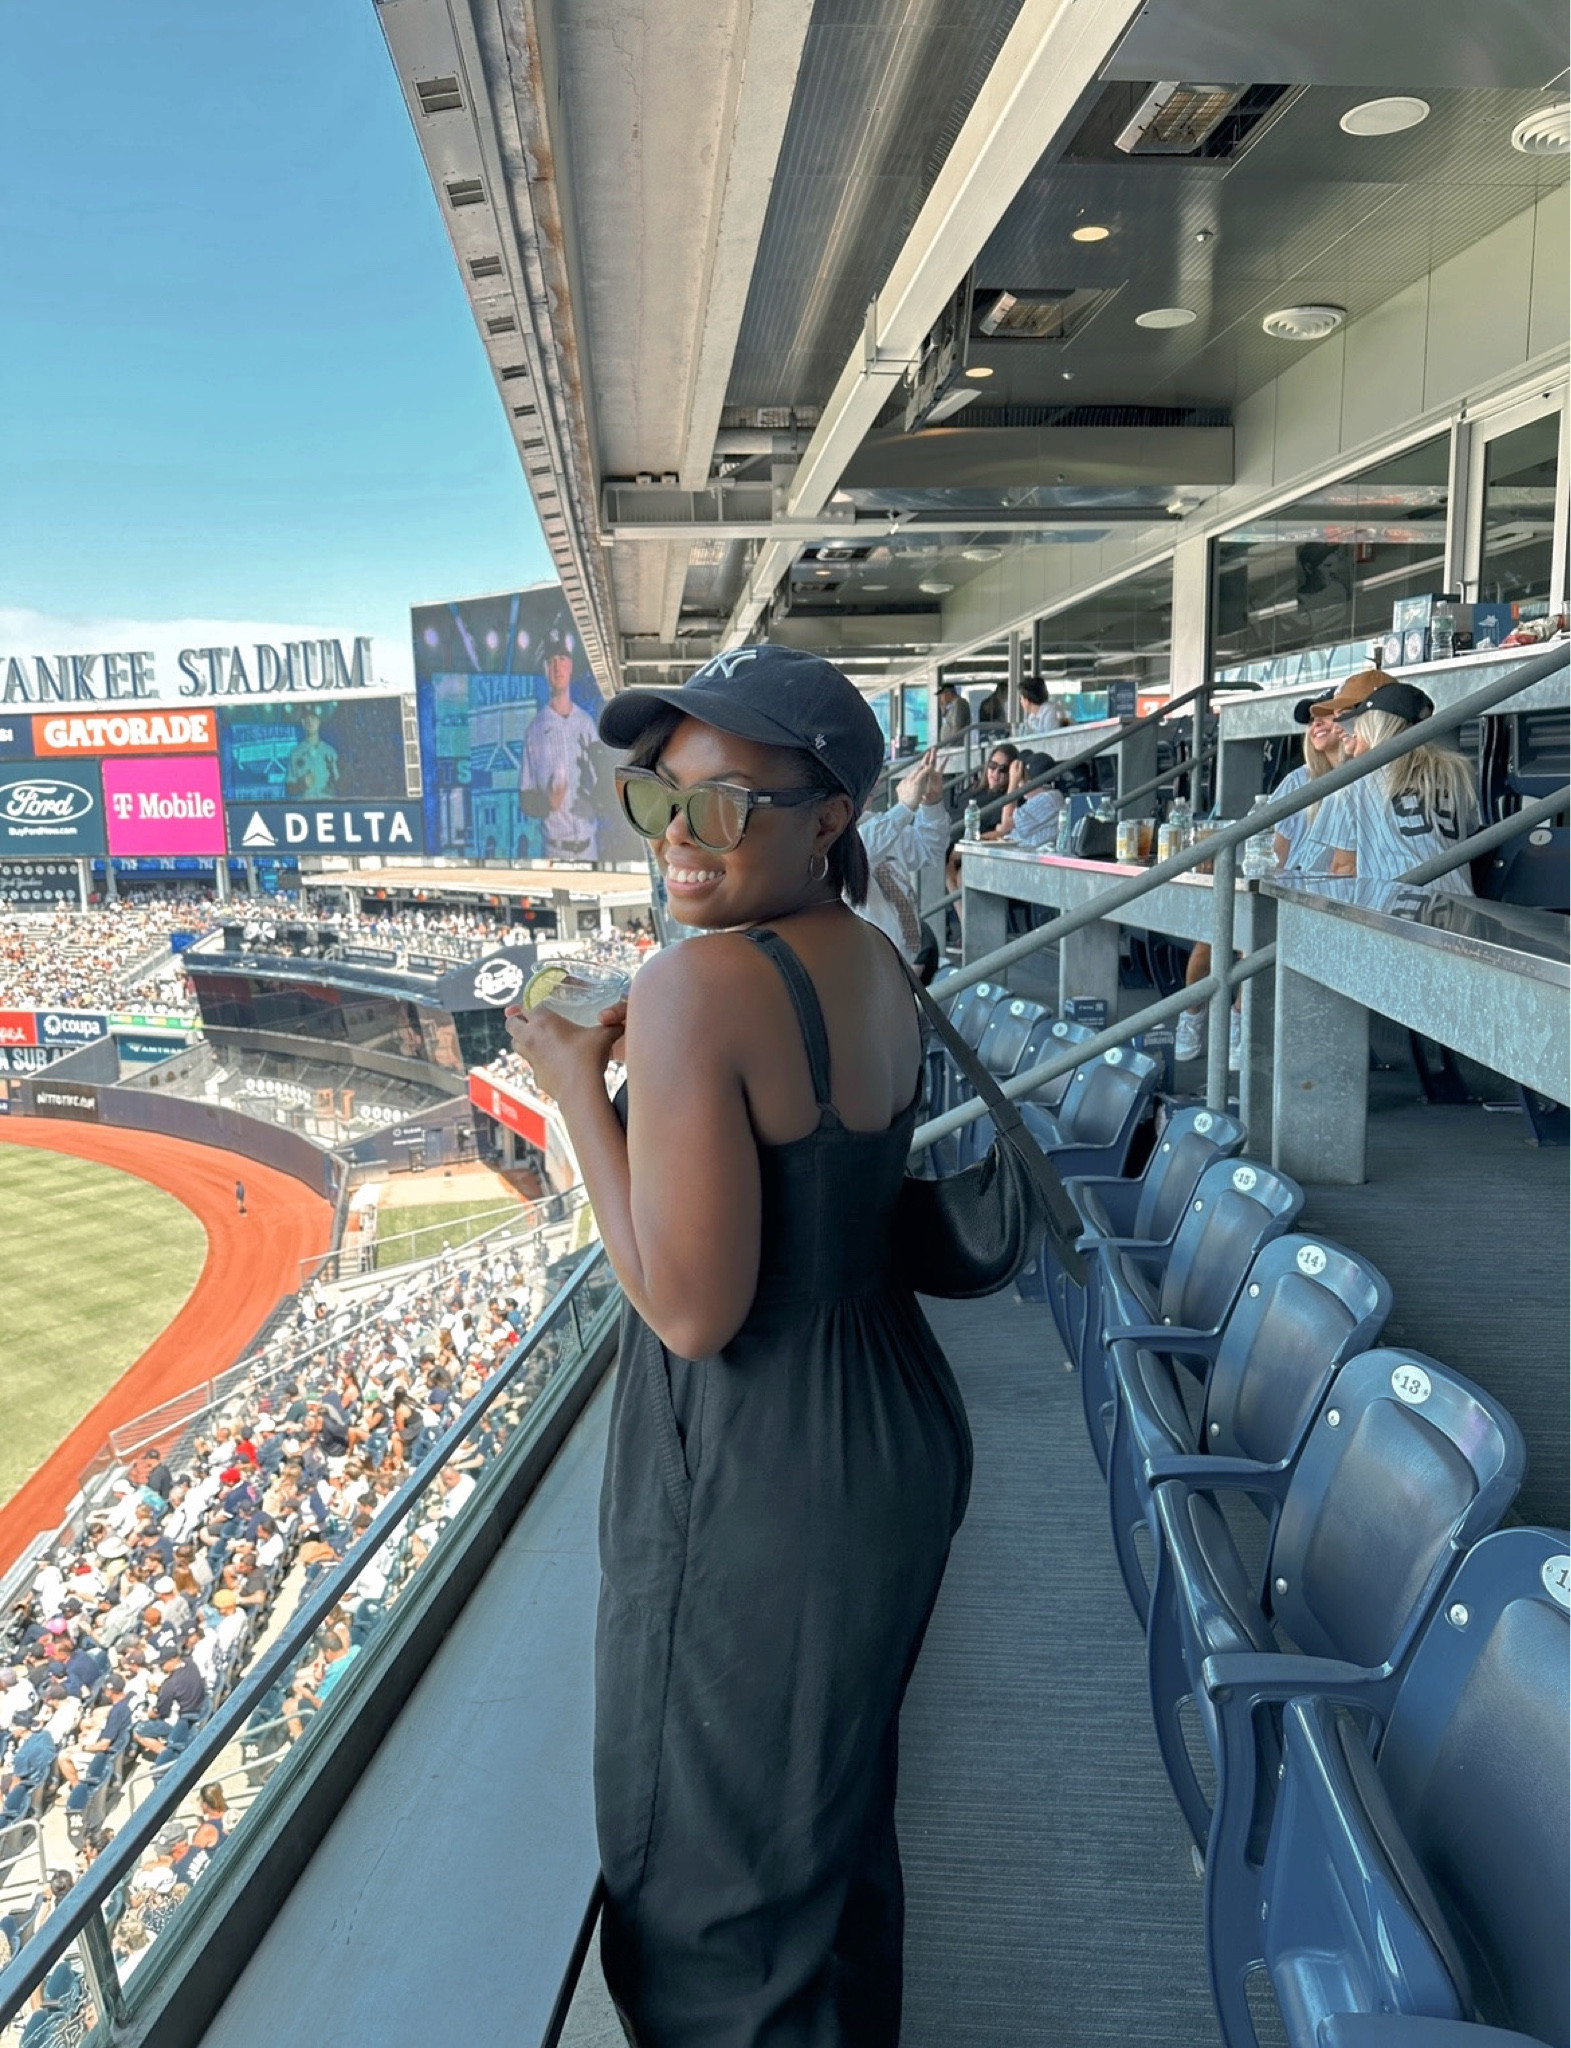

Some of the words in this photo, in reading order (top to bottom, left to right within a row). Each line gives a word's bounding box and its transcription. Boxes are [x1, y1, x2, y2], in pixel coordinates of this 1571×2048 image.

[0, 652, 160, 703] ANKEE
[177, 636, 375, 697] STADIUM
[44, 714, 209, 749] GATORADE
[7, 785, 75, 816] Ford
[113, 793, 133, 819] T
[138, 792, 216, 818] Mobile
[284, 811, 413, 843] DELTA
[62, 1019, 101, 1038] coupa
[12, 1047, 47, 1071] SUB
[1238, 1172, 1251, 1185] 15
[1304, 1252, 1320, 1267] 14
[1400, 1375, 1421, 1395] 13
[1556, 1568, 1570, 1591] 1
